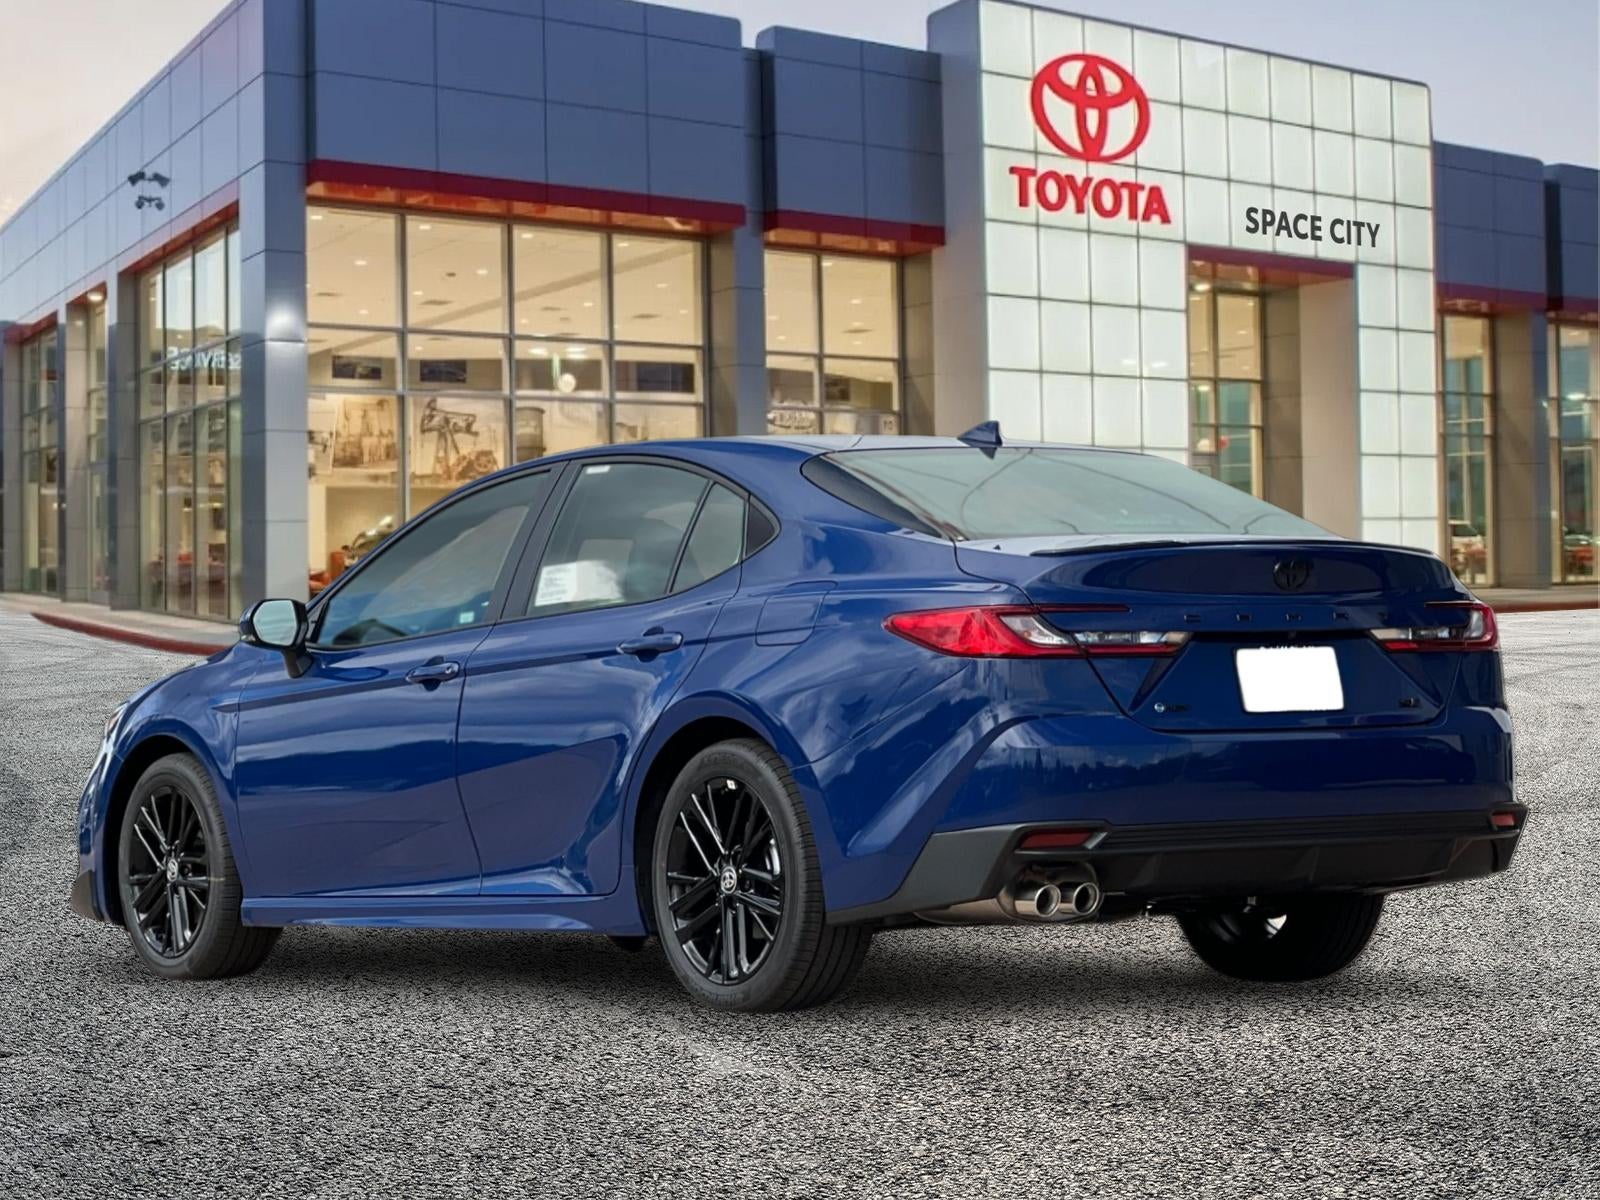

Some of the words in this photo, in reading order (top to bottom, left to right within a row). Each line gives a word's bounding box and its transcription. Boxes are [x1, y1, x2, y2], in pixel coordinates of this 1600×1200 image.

[1009, 167, 1171, 223] TOYOTA
[1245, 207, 1323, 241] SPACE
[1329, 218, 1381, 247] CITY
